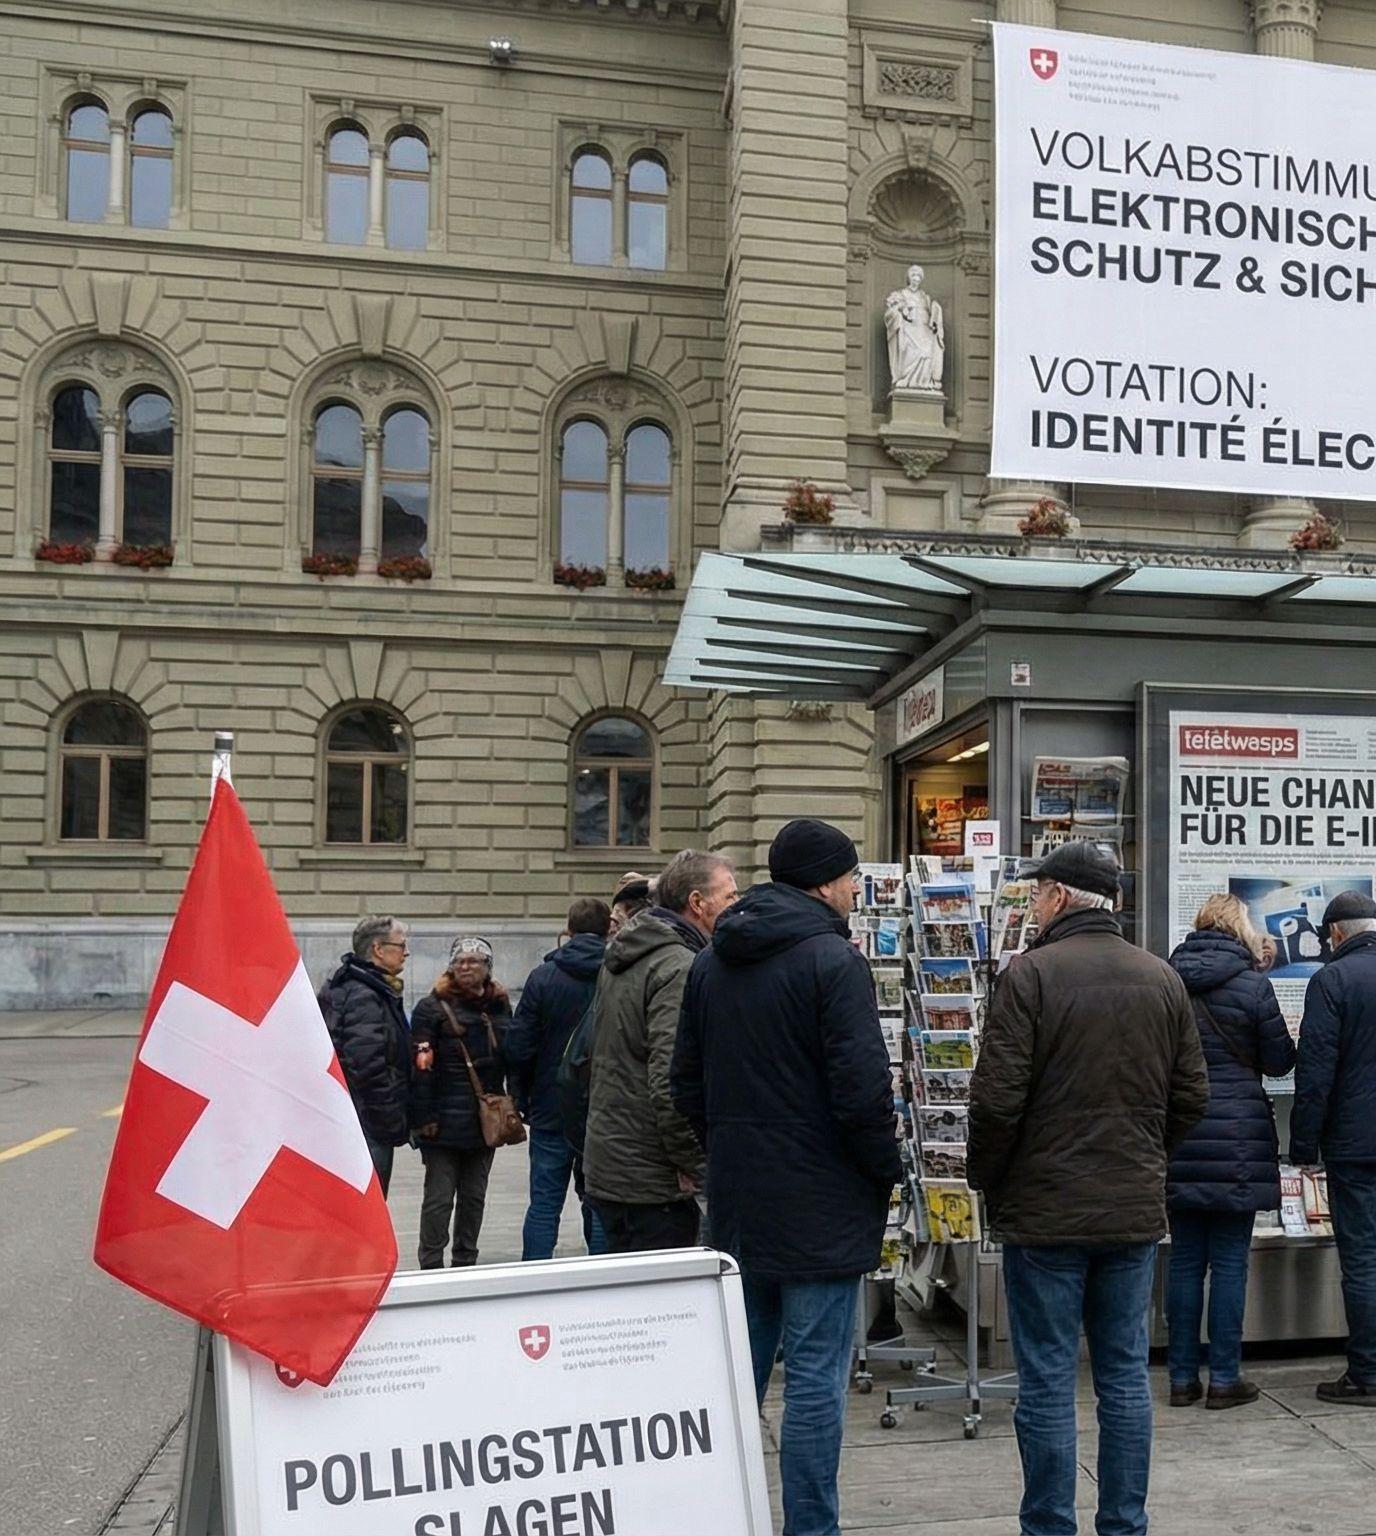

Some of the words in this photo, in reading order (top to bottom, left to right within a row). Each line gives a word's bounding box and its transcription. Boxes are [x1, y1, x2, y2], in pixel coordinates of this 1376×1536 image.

[1030, 236, 1222, 290] SCHUTZ
[1235, 256, 1267, 294] &
[1029, 354, 1267, 410] VOTATION:
[1031, 409, 1246, 462] IDENTITÉ
[1180, 774, 1270, 808] NEUE
[1180, 806, 1247, 846] FÜR
[1260, 814, 1314, 847] DIE
[284, 1408, 712, 1512] POLLINGSTATION
